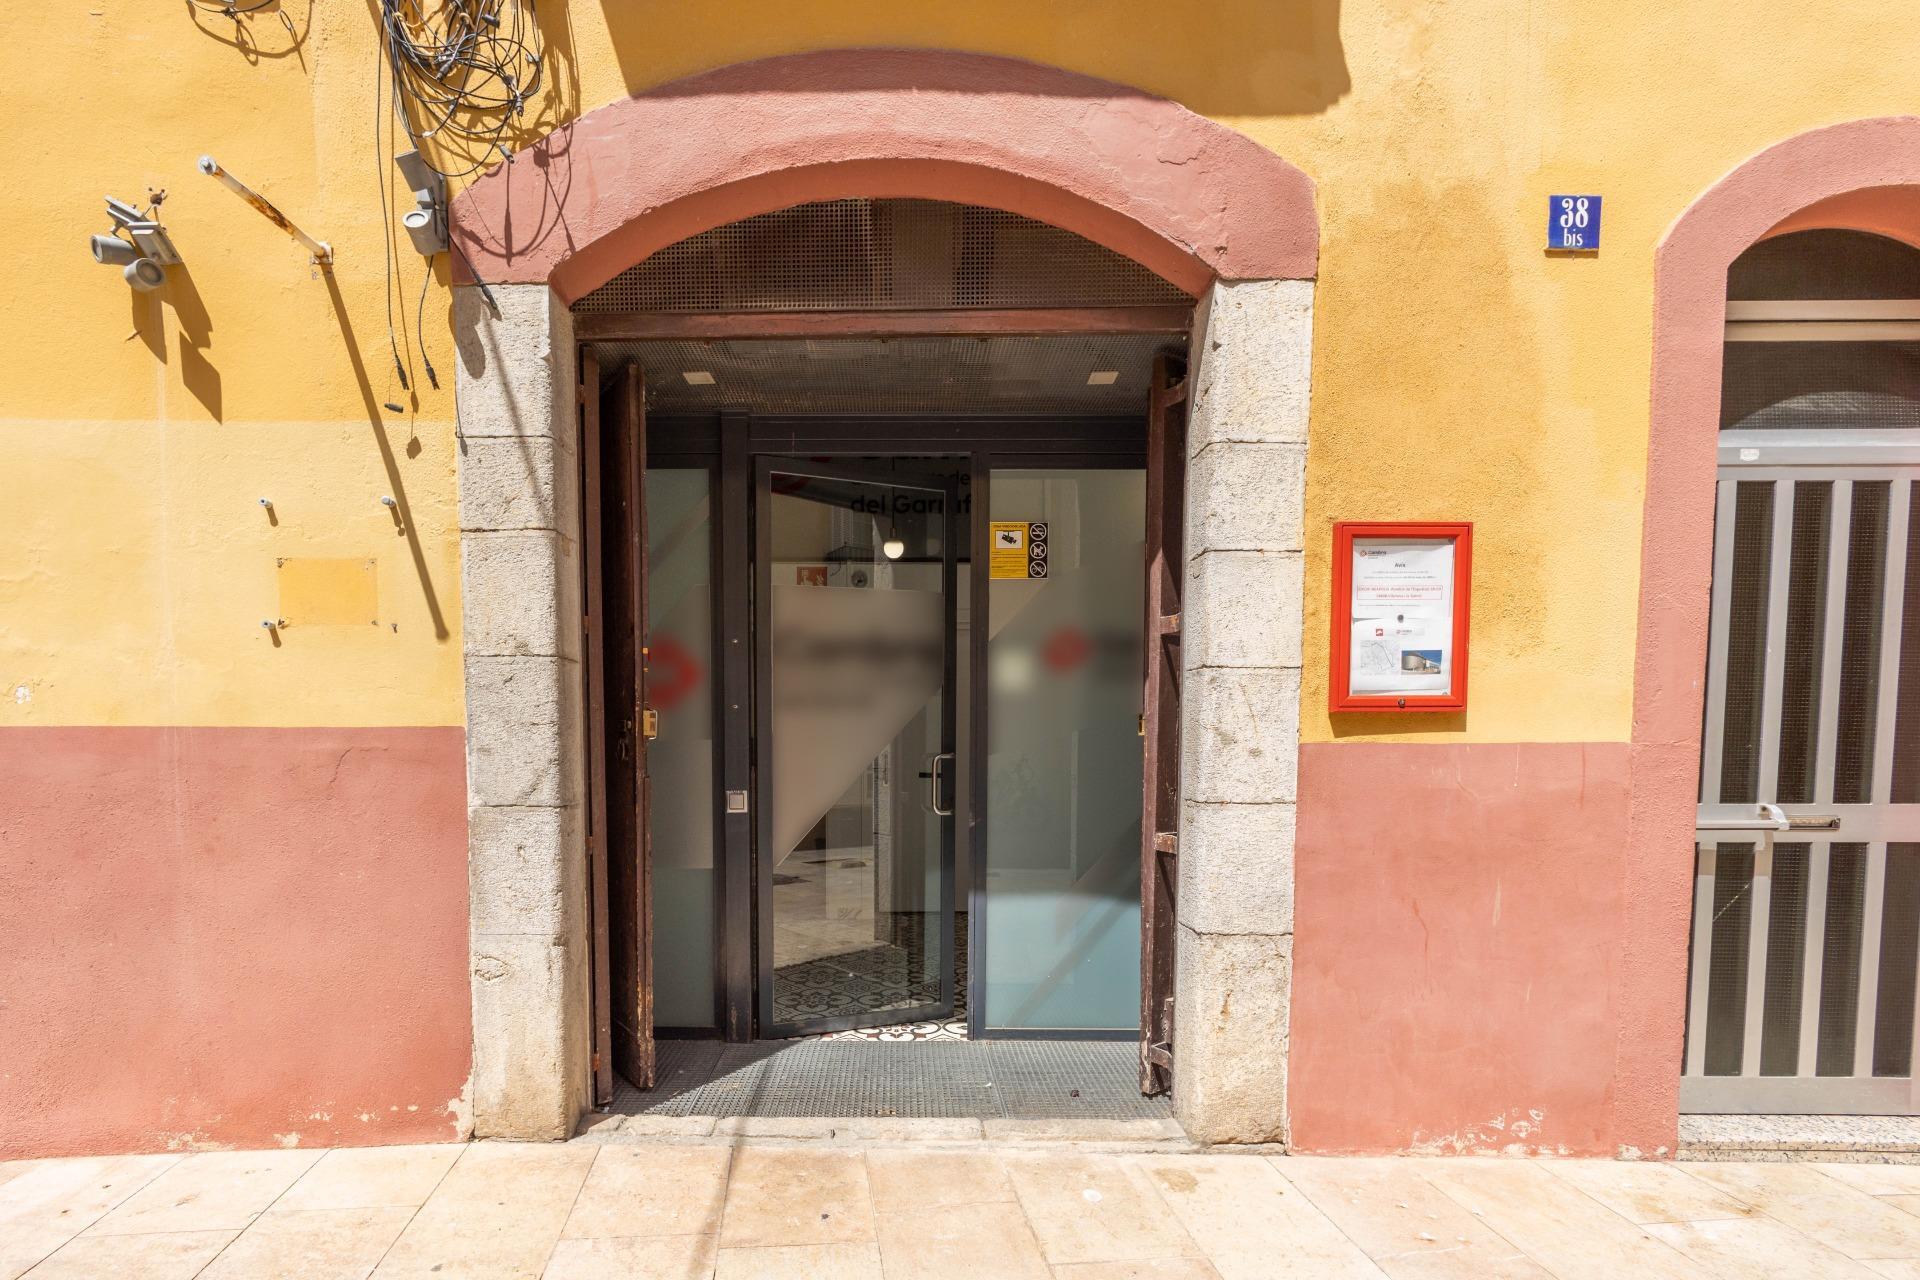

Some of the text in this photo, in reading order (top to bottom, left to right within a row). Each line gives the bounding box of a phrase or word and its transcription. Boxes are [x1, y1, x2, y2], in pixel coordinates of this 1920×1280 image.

[1560, 197, 1589, 228] 38
[1563, 228, 1584, 247] bis
[851, 494, 885, 513] del
